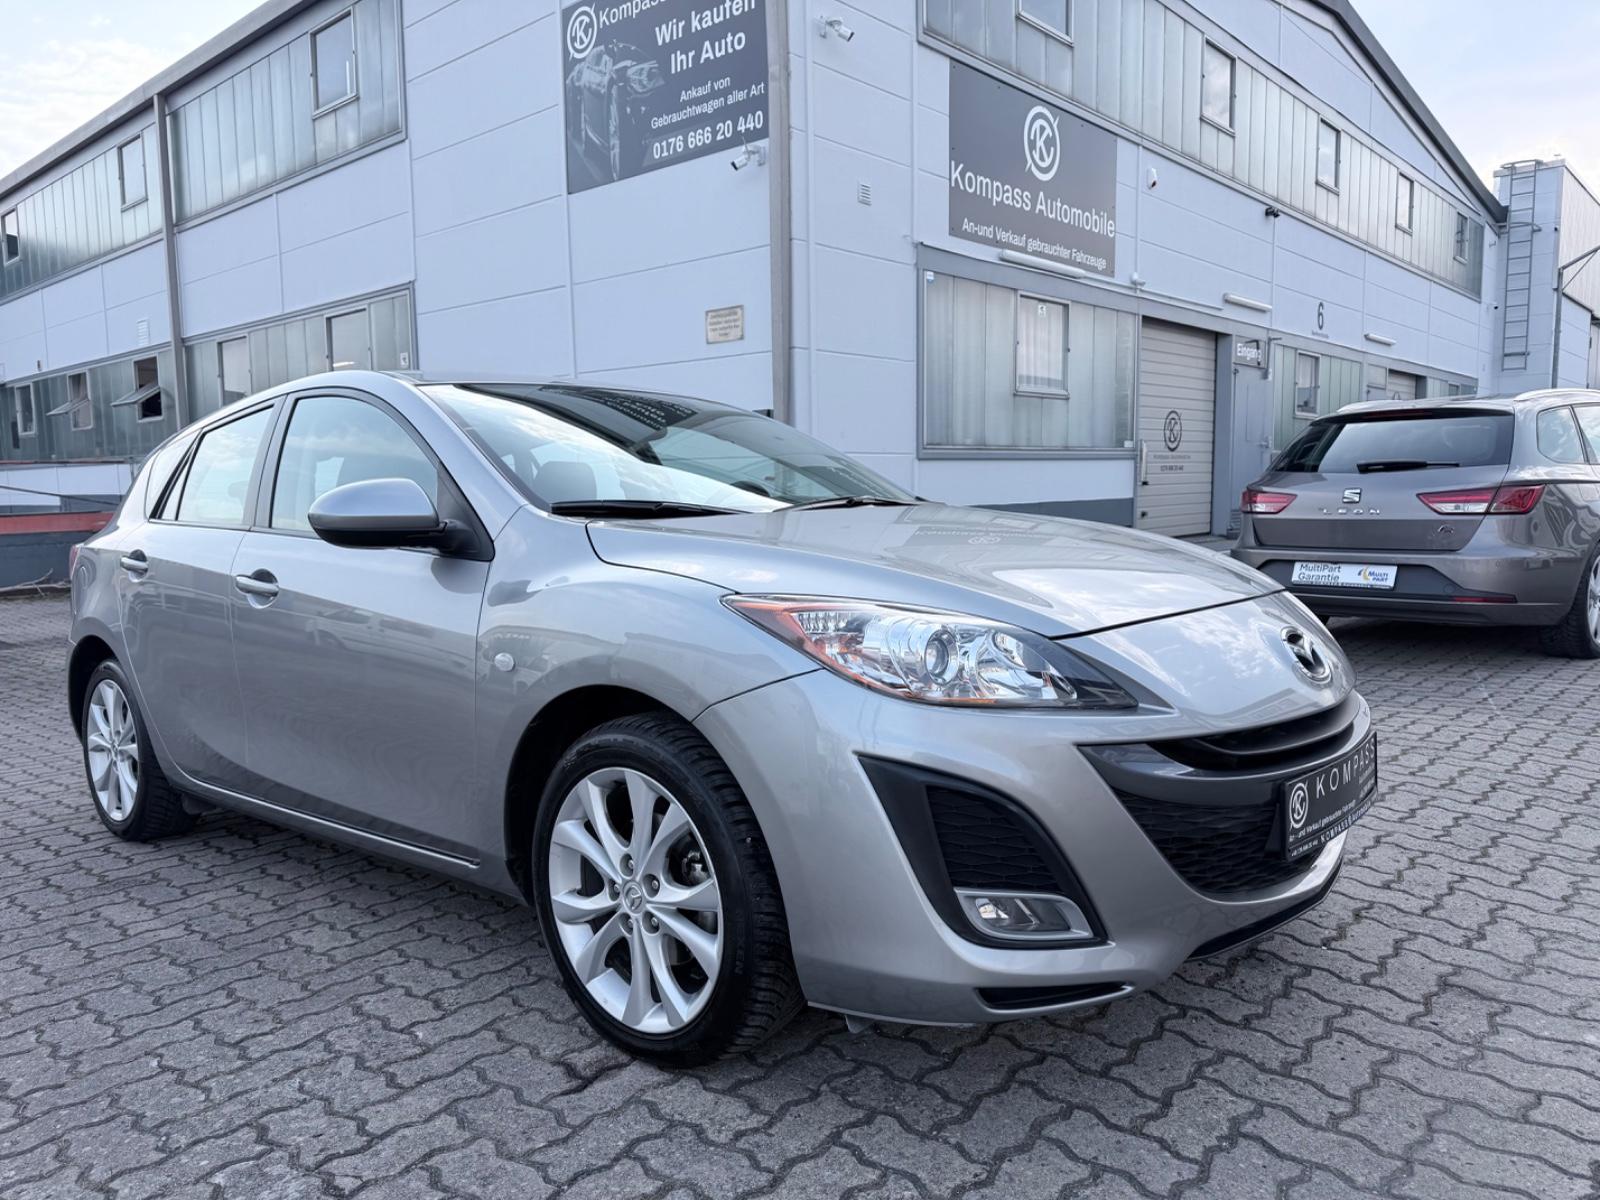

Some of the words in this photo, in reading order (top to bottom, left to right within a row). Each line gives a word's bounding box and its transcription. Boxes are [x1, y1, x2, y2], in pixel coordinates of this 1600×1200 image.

[655, 18, 685, 46] Wir
[671, 50, 695, 74] Ihr
[700, 32, 746, 64] Auto
[651, 97, 725, 129] Gebrauchtwagen
[727, 89, 748, 105] aller
[750, 82, 765, 98] Art
[680, 81, 711, 102] Ankauf
[713, 77, 731, 91] von
[653, 137, 684, 159] 0176
[688, 127, 712, 149] 666
[716, 120, 733, 141] 20
[737, 111, 764, 133] 440
[951, 160, 1032, 211] Kompass
[1035, 191, 1116, 238] Automobile
[995, 228, 1026, 248] Verkauf
[1027, 238, 1071, 259] gebrauchter
[1072, 249, 1107, 270] Fahrzeuge
[1317, 302, 1324, 330] 6
[1323, 507, 1381, 515] LEON
[1298, 572, 1340, 581] Garantie
[1300, 563, 1341, 573] MultiPart
[1316, 738, 1375, 799] KOMPASS
